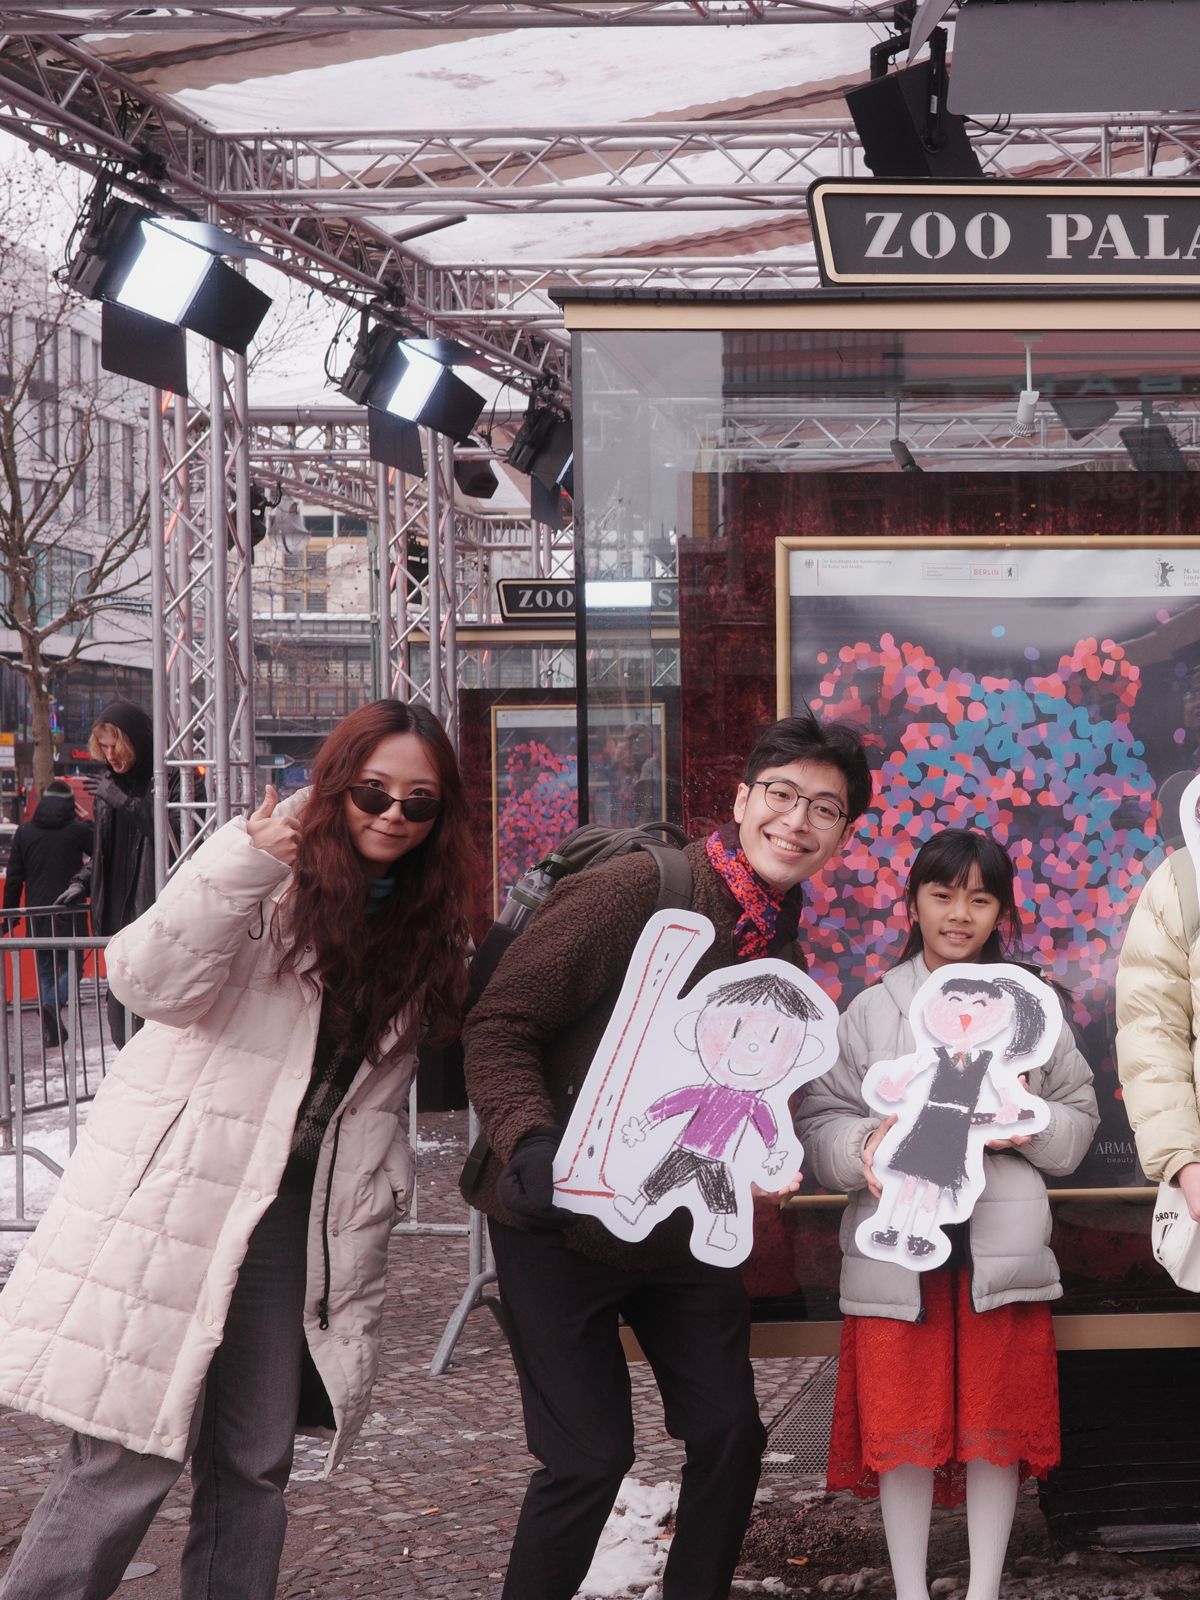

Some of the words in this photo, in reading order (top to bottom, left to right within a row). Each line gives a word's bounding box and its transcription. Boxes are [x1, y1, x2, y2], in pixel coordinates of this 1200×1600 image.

[864, 211, 1011, 260] ZOO
[973, 568, 999, 576] BERLIN
[518, 589, 574, 608] ZOO
[1106, 1156, 1134, 1164] beauty
